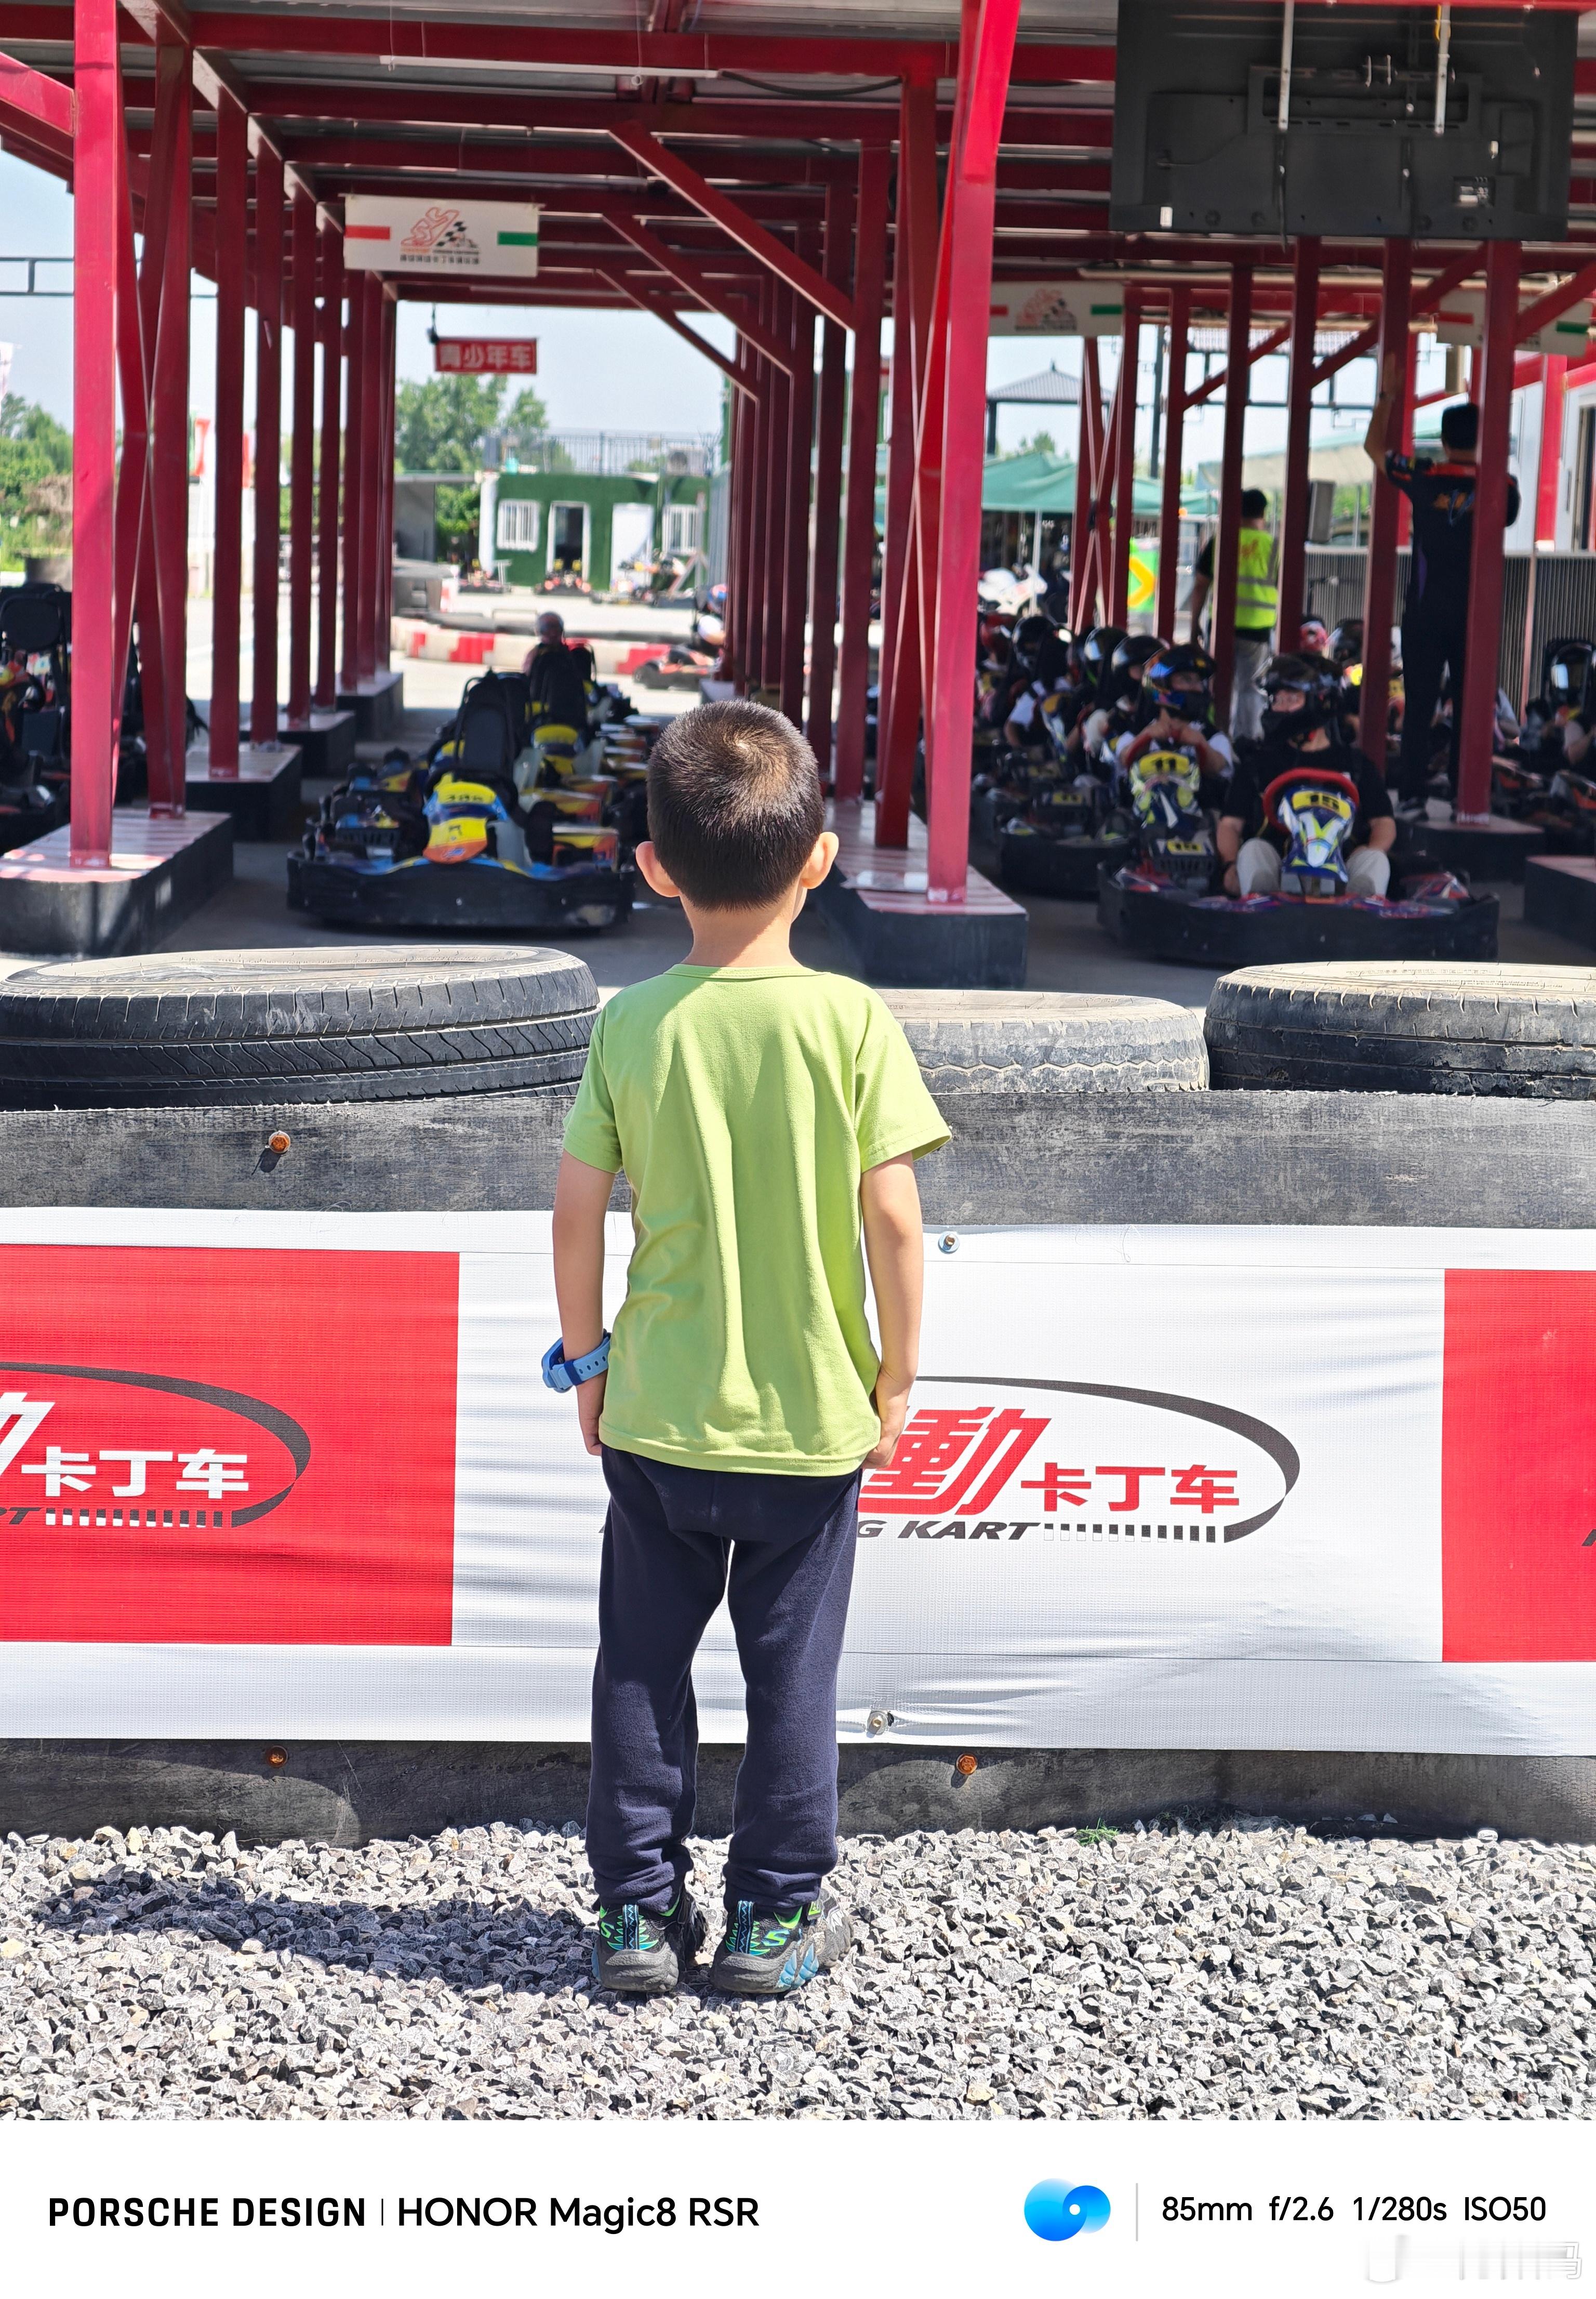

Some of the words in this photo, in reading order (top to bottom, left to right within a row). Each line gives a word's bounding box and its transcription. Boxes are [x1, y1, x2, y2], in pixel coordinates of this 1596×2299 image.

[21, 1446, 249, 1499] 卡丁车
[1021, 1462, 1240, 1514] 卡丁车
[898, 1521, 1041, 1540] KART
